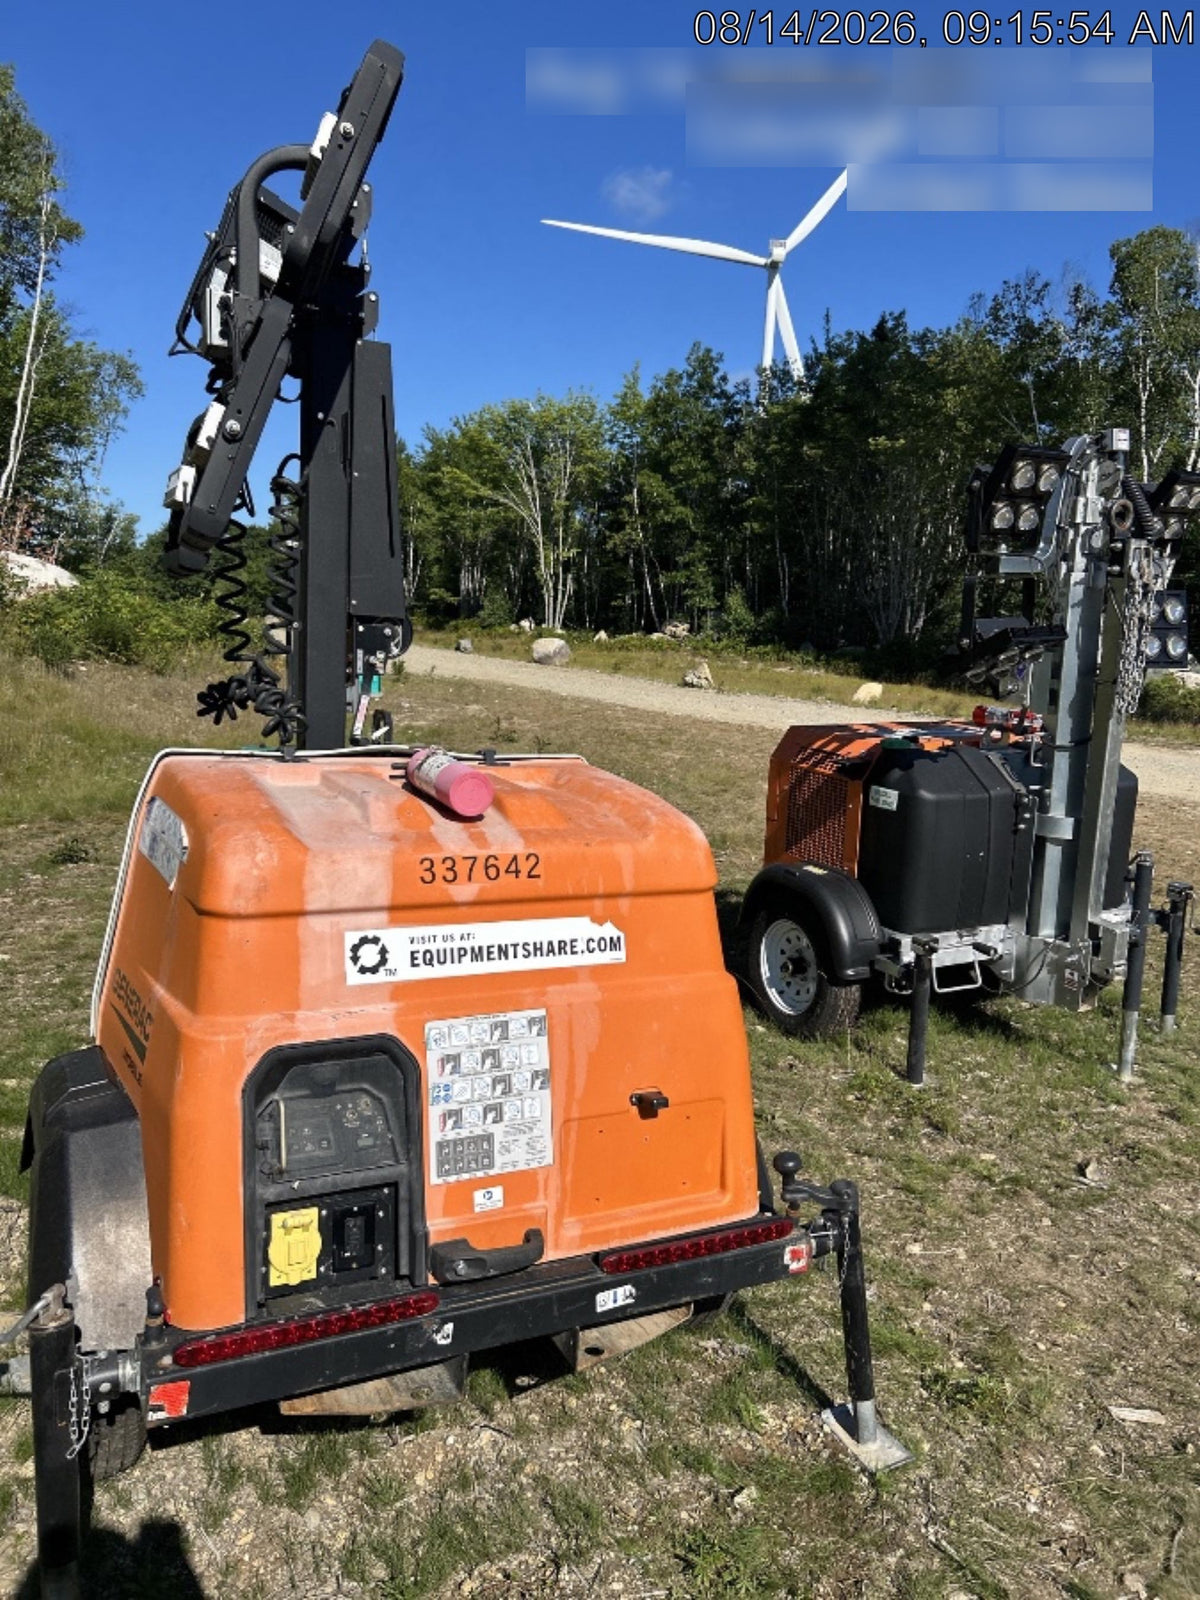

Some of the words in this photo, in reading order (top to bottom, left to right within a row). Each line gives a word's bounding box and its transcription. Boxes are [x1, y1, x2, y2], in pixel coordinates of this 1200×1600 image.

[419, 852, 541, 884] 337642
[408, 934, 438, 945] VISIT
[442, 932, 456, 943] US
[460, 932, 476, 942] AT:
[410, 936, 621, 968] EQUIPMENTSHARE.COM
